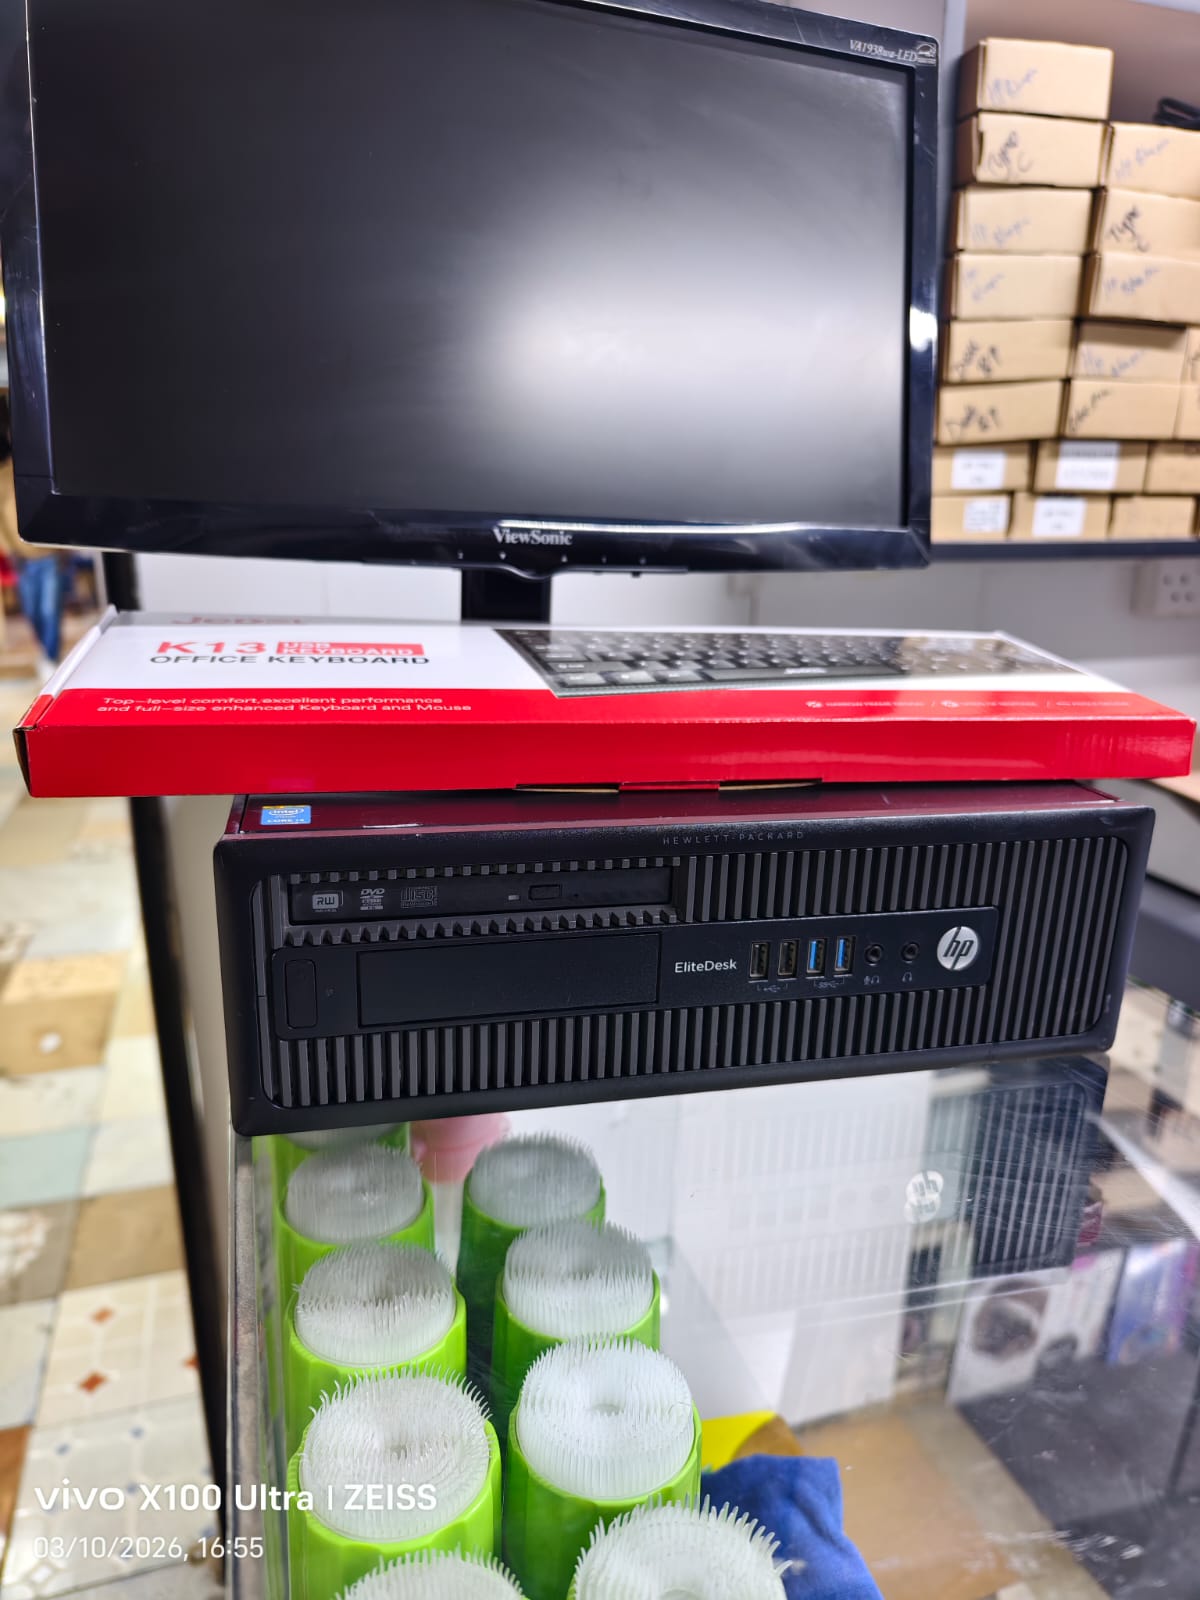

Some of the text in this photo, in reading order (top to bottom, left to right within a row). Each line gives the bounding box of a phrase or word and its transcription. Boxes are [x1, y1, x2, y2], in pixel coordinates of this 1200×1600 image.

[492, 526, 573, 546] ViewSonic
[156, 641, 267, 654] K13
[283, 647, 414, 655] KEYBOARD
[150, 655, 430, 665] OFFICE KEYBOARD
[103, 697, 187, 705] Top-level
[340, 697, 443, 705] performance
[299, 704, 377, 712] Keyboard
[360, 887, 385, 896] DVD
[941, 926, 976, 970] hp
[673, 958, 738, 974] EliteDesk
